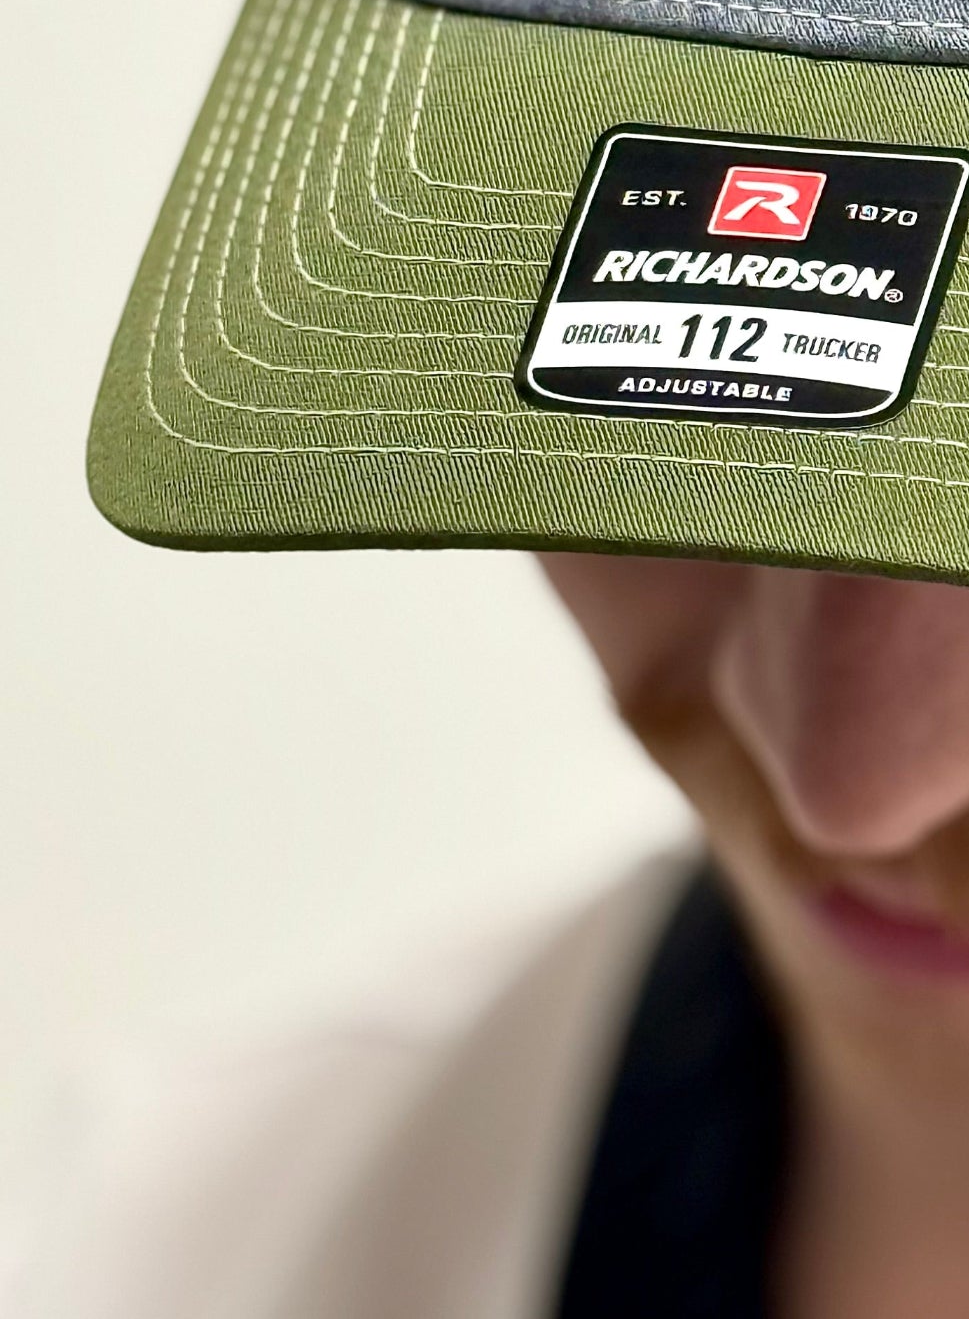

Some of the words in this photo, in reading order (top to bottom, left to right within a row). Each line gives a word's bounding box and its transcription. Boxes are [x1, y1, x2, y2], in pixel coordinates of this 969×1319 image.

[622, 189, 687, 207] EST.
[845, 202, 918, 226] 1970
[562, 322, 662, 346] ORIGINAL
[678, 313, 768, 363] 112
[782, 332, 881, 363] TRUCKER
[617, 376, 793, 402] ADJUSTABLE
